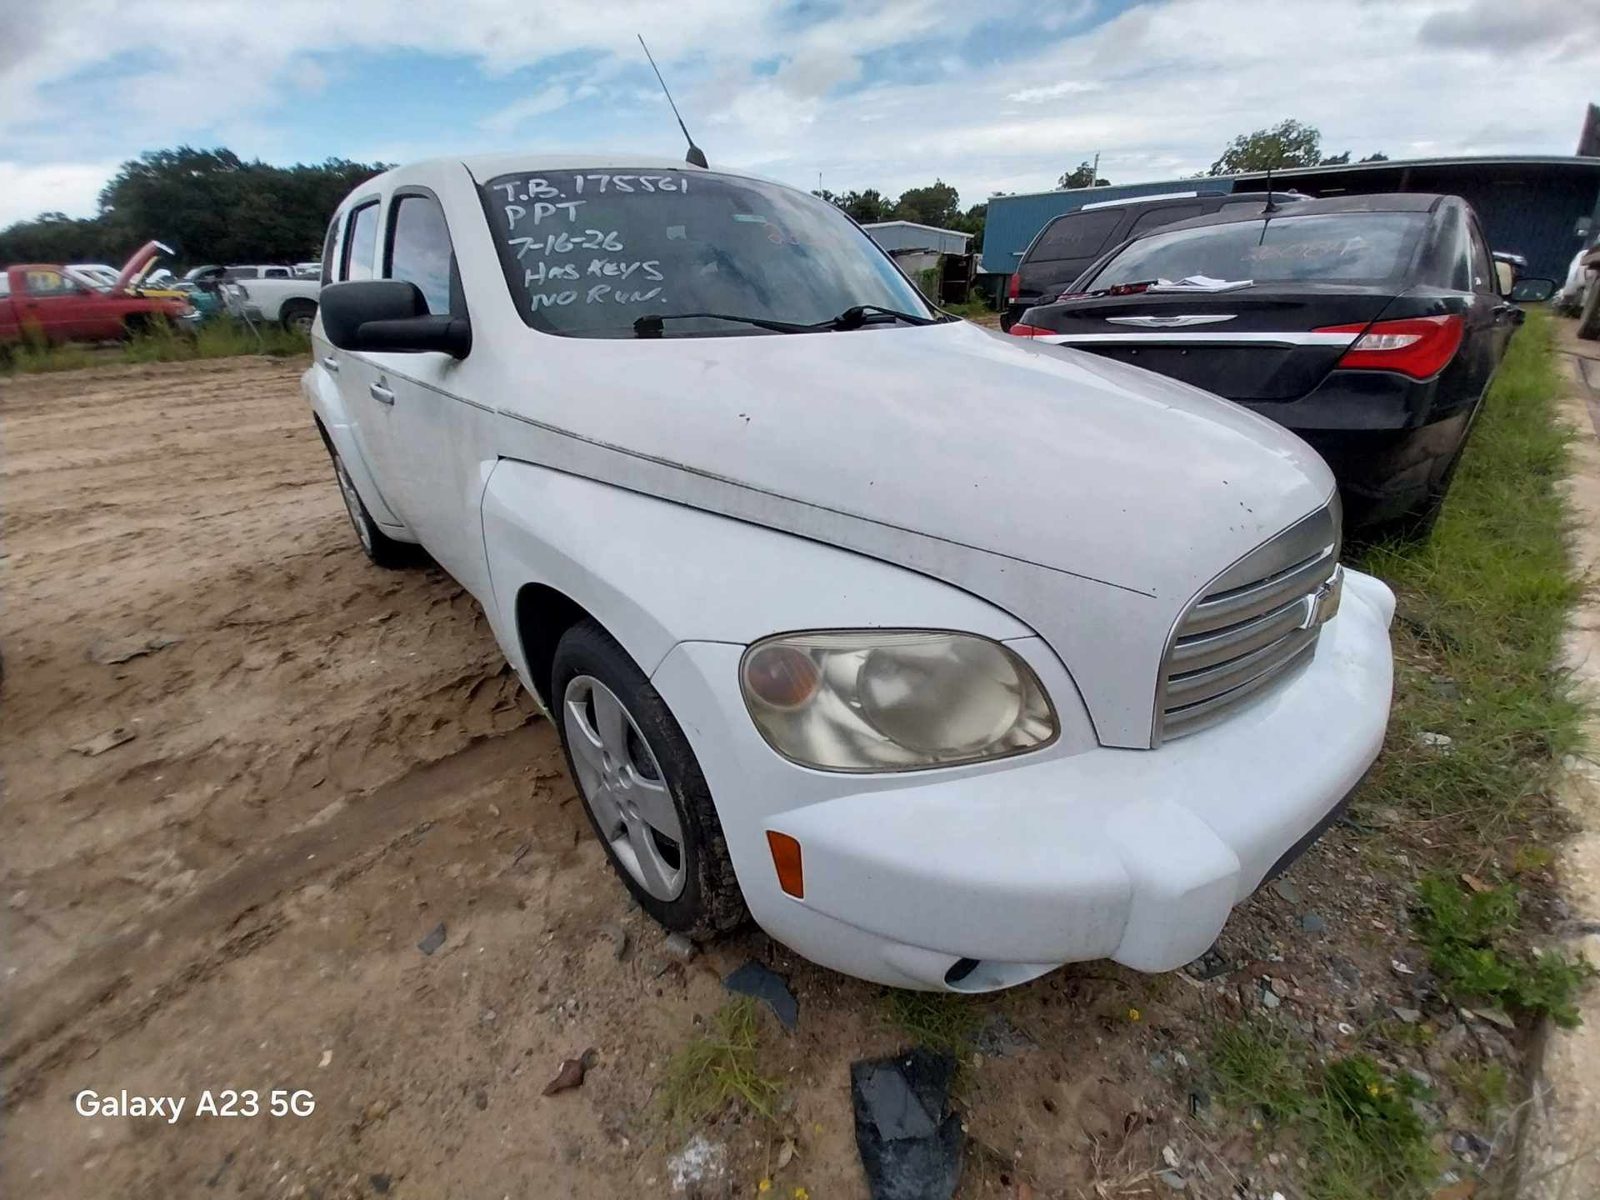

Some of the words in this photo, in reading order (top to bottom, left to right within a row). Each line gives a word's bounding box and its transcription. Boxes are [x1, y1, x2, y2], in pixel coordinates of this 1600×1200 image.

[493, 179, 566, 202] T.B.
[574, 174, 688, 194] 175561
[504, 200, 588, 230] PPT
[508, 229, 624, 259] 7-16-26
